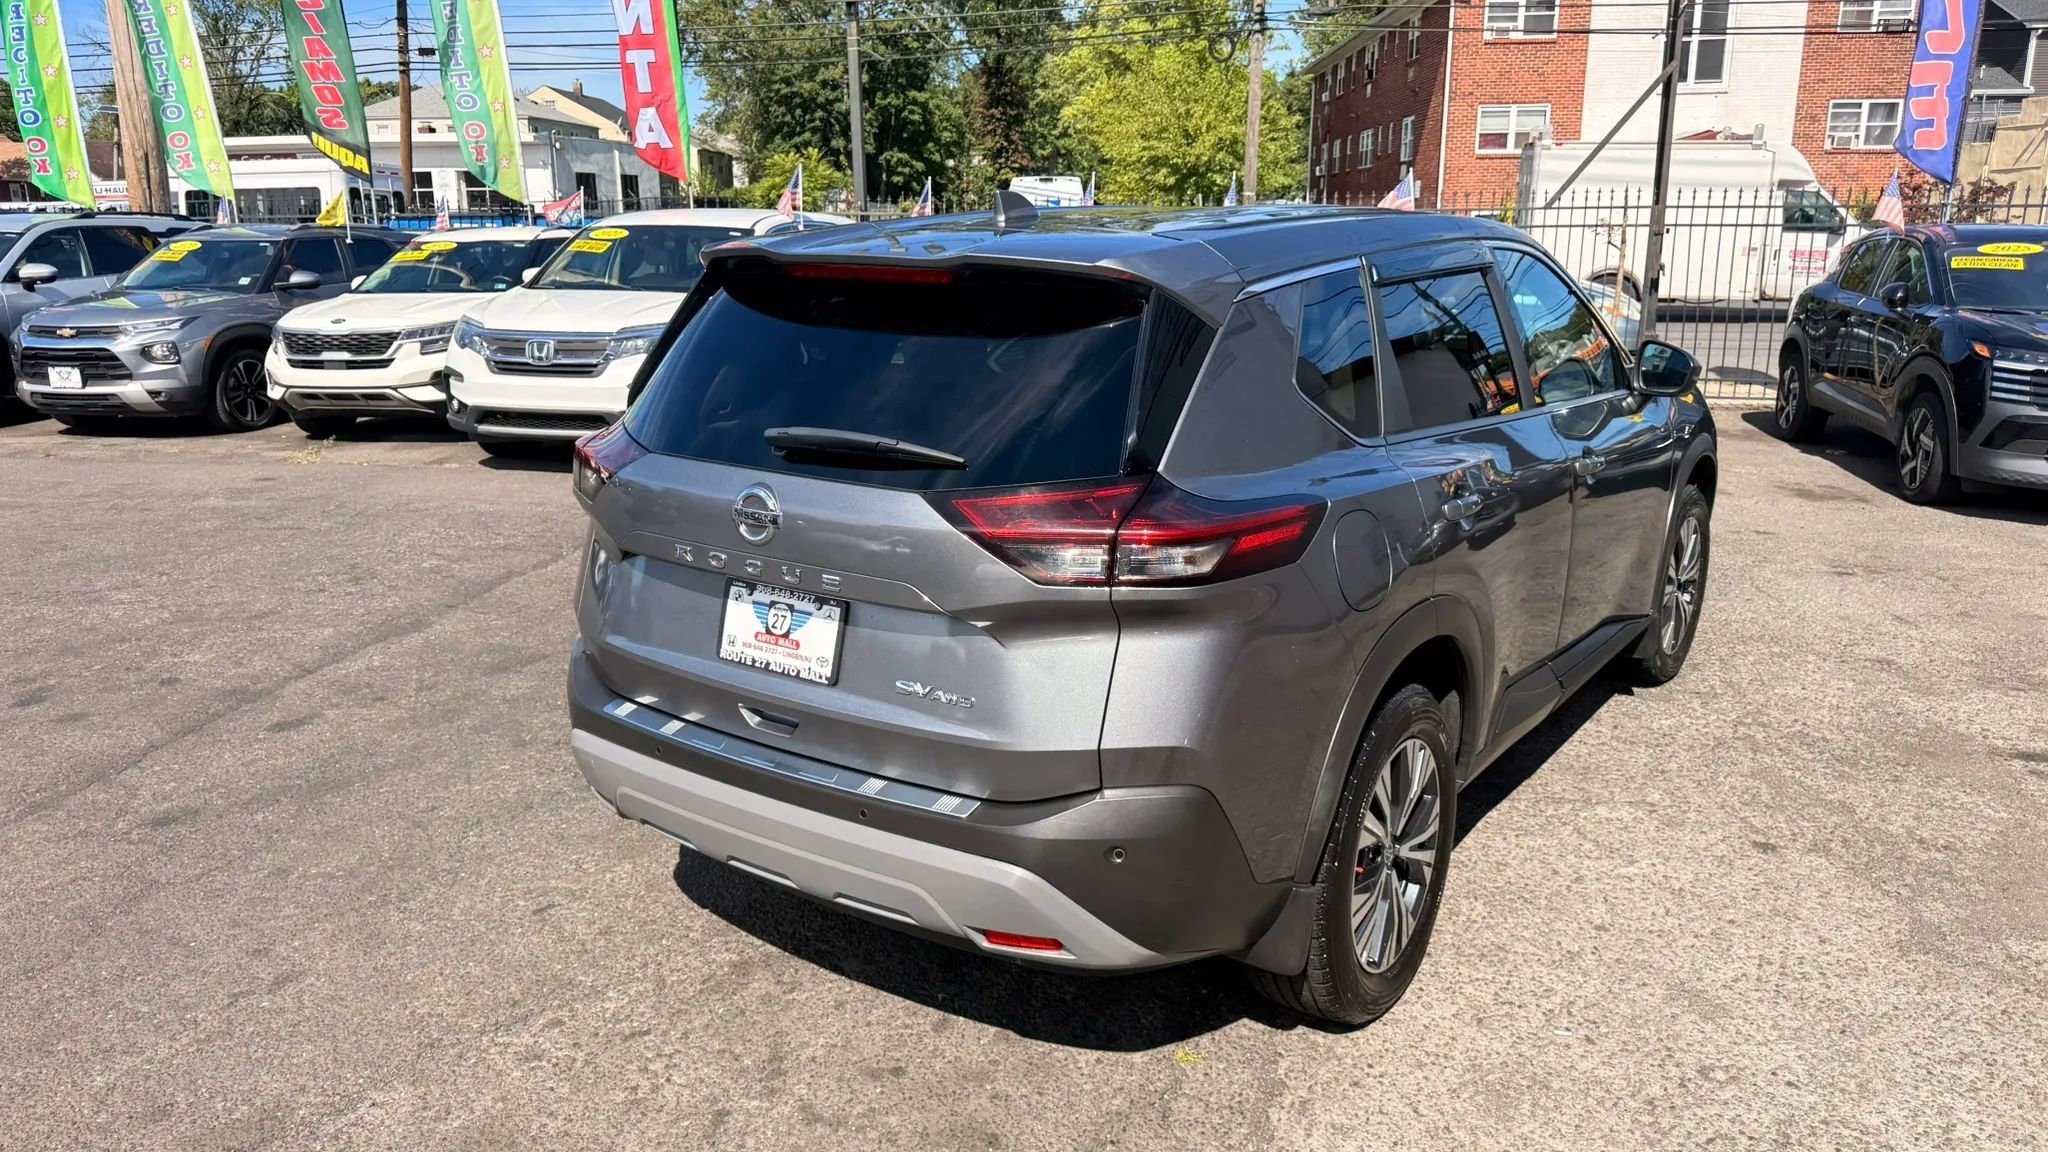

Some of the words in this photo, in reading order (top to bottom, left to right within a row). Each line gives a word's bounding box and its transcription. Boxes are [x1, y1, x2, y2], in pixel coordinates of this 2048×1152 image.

[1992, 244, 2031, 252] 2025
[735, 508, 778, 526] NISSAN
[675, 543, 842, 593] ROGUE
[756, 584, 816, 605] 908-648-2727
[771, 613, 787, 631] 27
[757, 632, 776, 644] AUTO
[777, 637, 798, 649] MALL
[719, 648, 753, 665] ROUTE
[754, 656, 766, 669] 27
[768, 660, 797, 676] AUTO
[798, 667, 828, 684] MALL
[896, 680, 934, 698] SV
[930, 690, 976, 708] AWD
